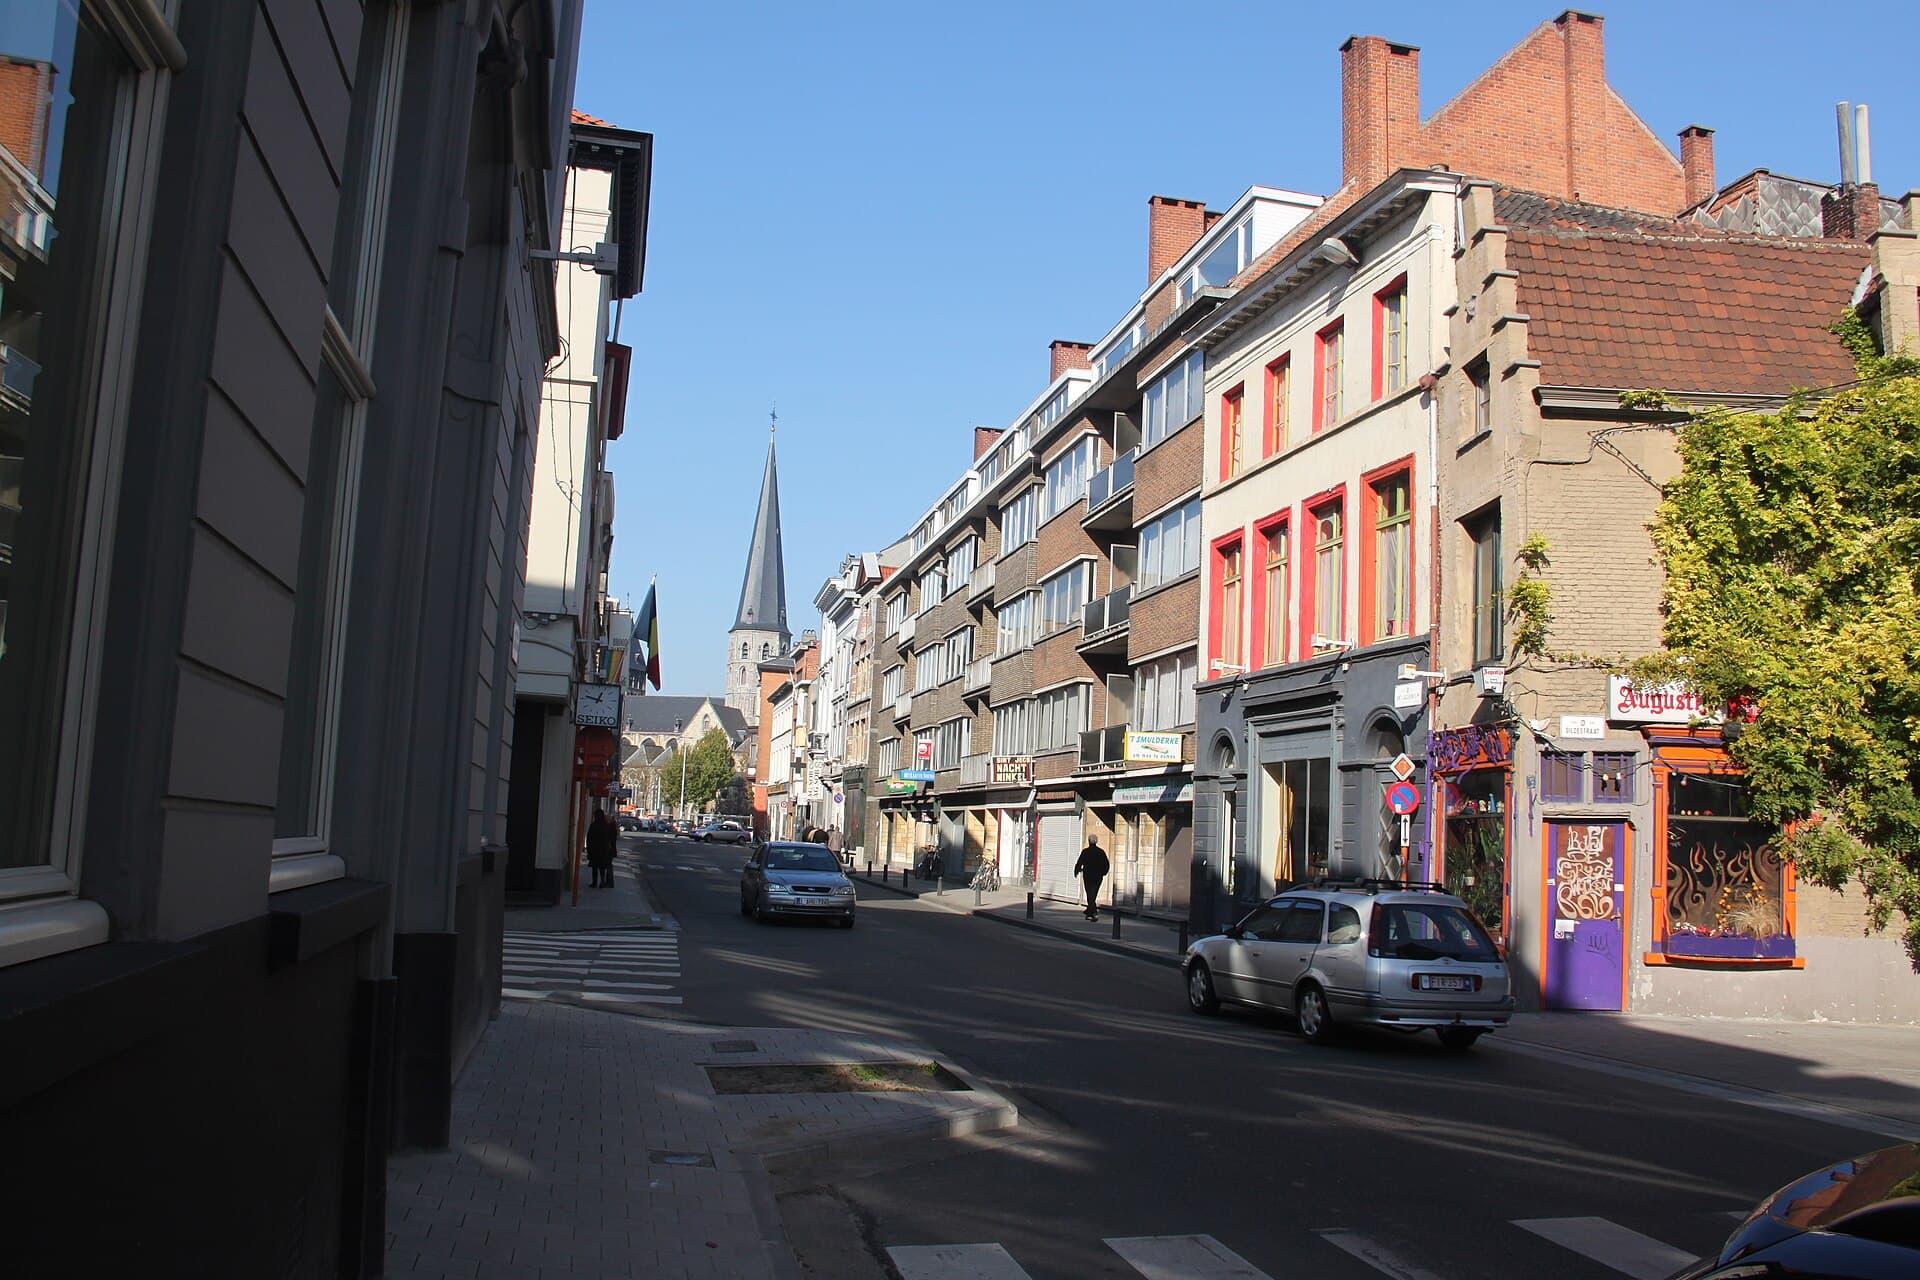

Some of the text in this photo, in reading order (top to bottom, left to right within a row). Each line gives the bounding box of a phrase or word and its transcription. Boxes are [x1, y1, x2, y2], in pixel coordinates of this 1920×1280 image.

[1617, 685, 1718, 716] Augusti
[577, 714, 616, 725] SEIKO
[1136, 735, 1180, 745] SMULDERKE
[997, 763, 1027, 772] NACHT
